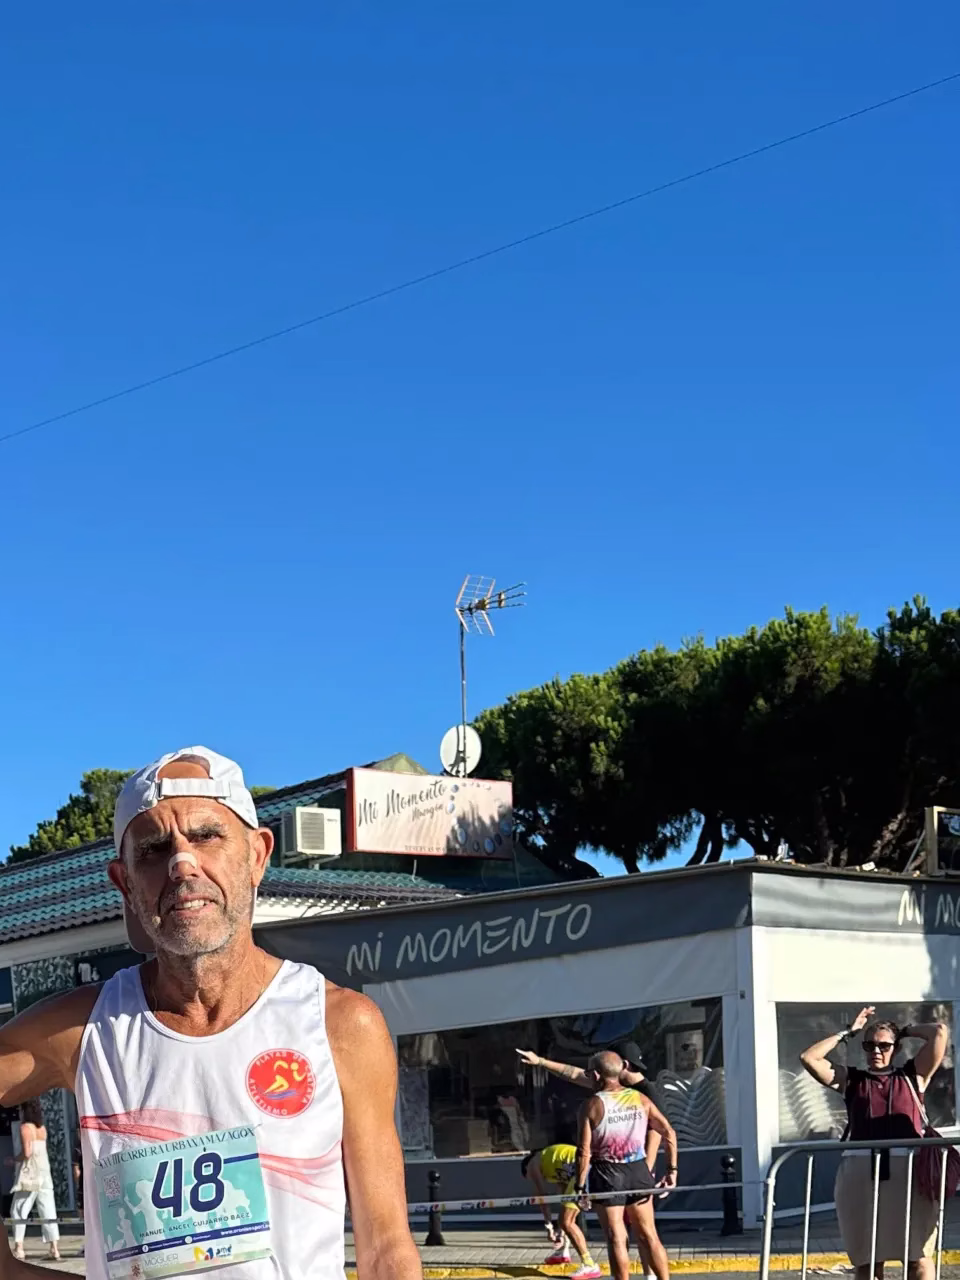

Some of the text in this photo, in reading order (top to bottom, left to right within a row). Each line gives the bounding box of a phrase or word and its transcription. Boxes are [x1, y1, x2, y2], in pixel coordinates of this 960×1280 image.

[358, 780, 447, 827] Mi Momento
[396, 903, 592, 969] MOMENTO
[255, 1051, 287, 1066] PLAYAS
[249, 1078, 288, 1115] ATLETISMO
[608, 1112, 642, 1124] BONARES
[121, 1146, 164, 1162] CARRERA
[166, 1138, 205, 1153] URBANA
[151, 1152, 225, 1218] 48
[139, 1228, 166, 1238] MANUEL
[192, 1216, 229, 1227] GUIJARRO
[144, 1253, 179, 1267] MOGUER
